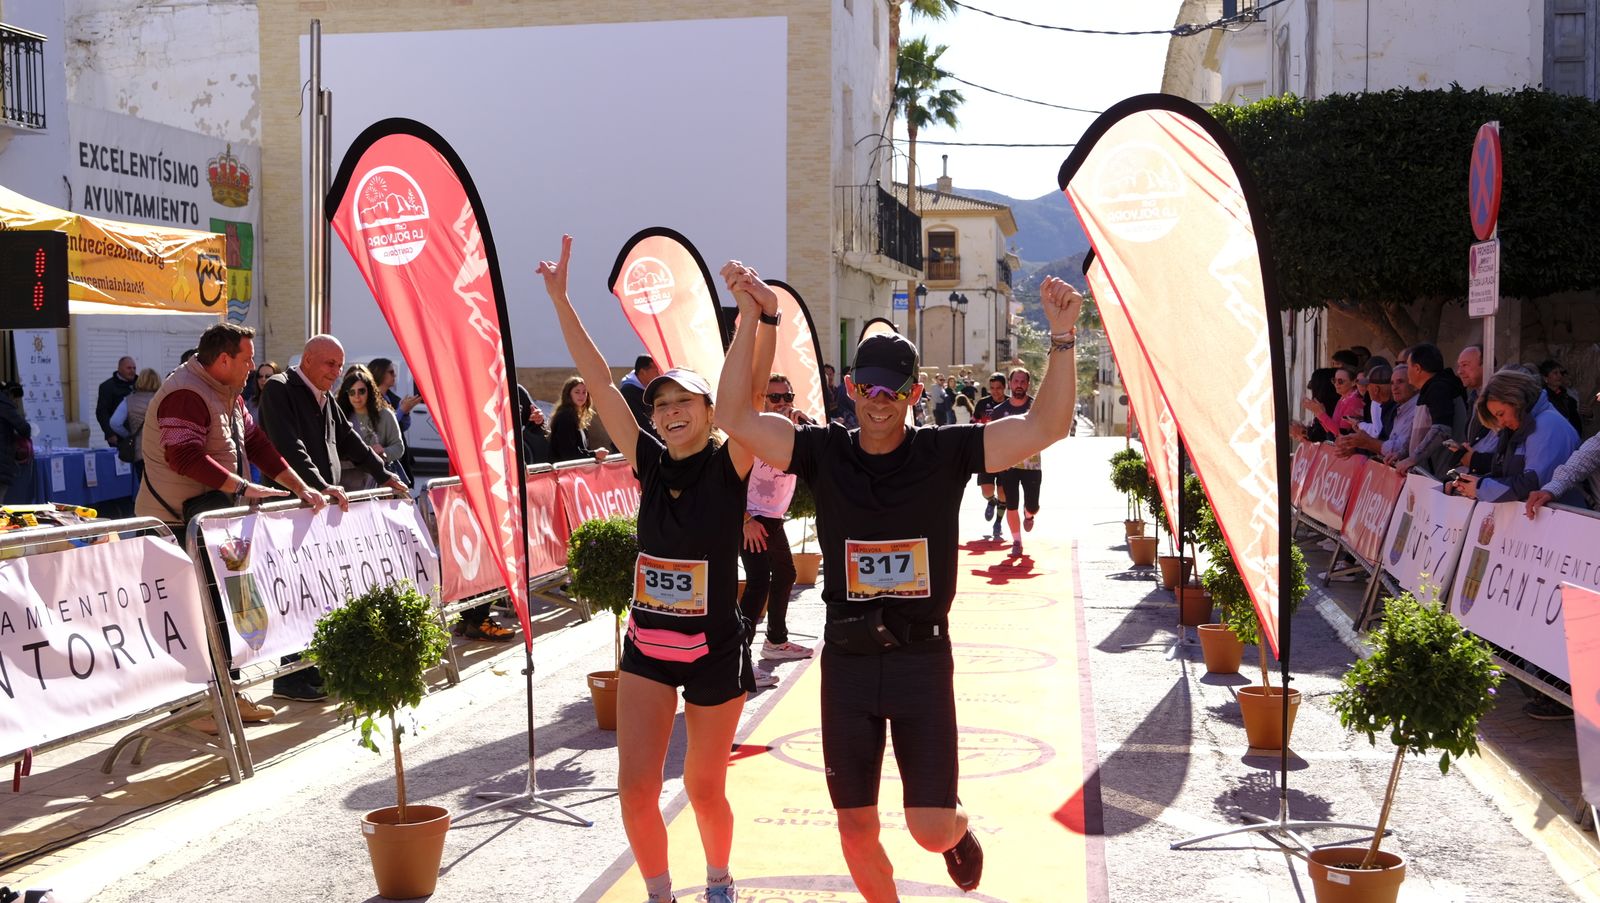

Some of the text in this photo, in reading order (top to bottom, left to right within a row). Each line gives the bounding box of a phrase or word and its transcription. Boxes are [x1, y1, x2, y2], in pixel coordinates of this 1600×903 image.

[79, 142, 199, 188] EXCELENTÍSIMO
[84, 185, 199, 225] AYUNTAMIENTO
[265, 528, 419, 568] AYUNTAMIENTO DE
[859, 554, 910, 575] 317
[273, 551, 429, 616] CANTORIA
[645, 569, 692, 592] 353
[1487, 563, 1563, 626] CANTO
[0, 578, 168, 636] AMIENTO DE
[734, 886, 838, 899] Cantori
